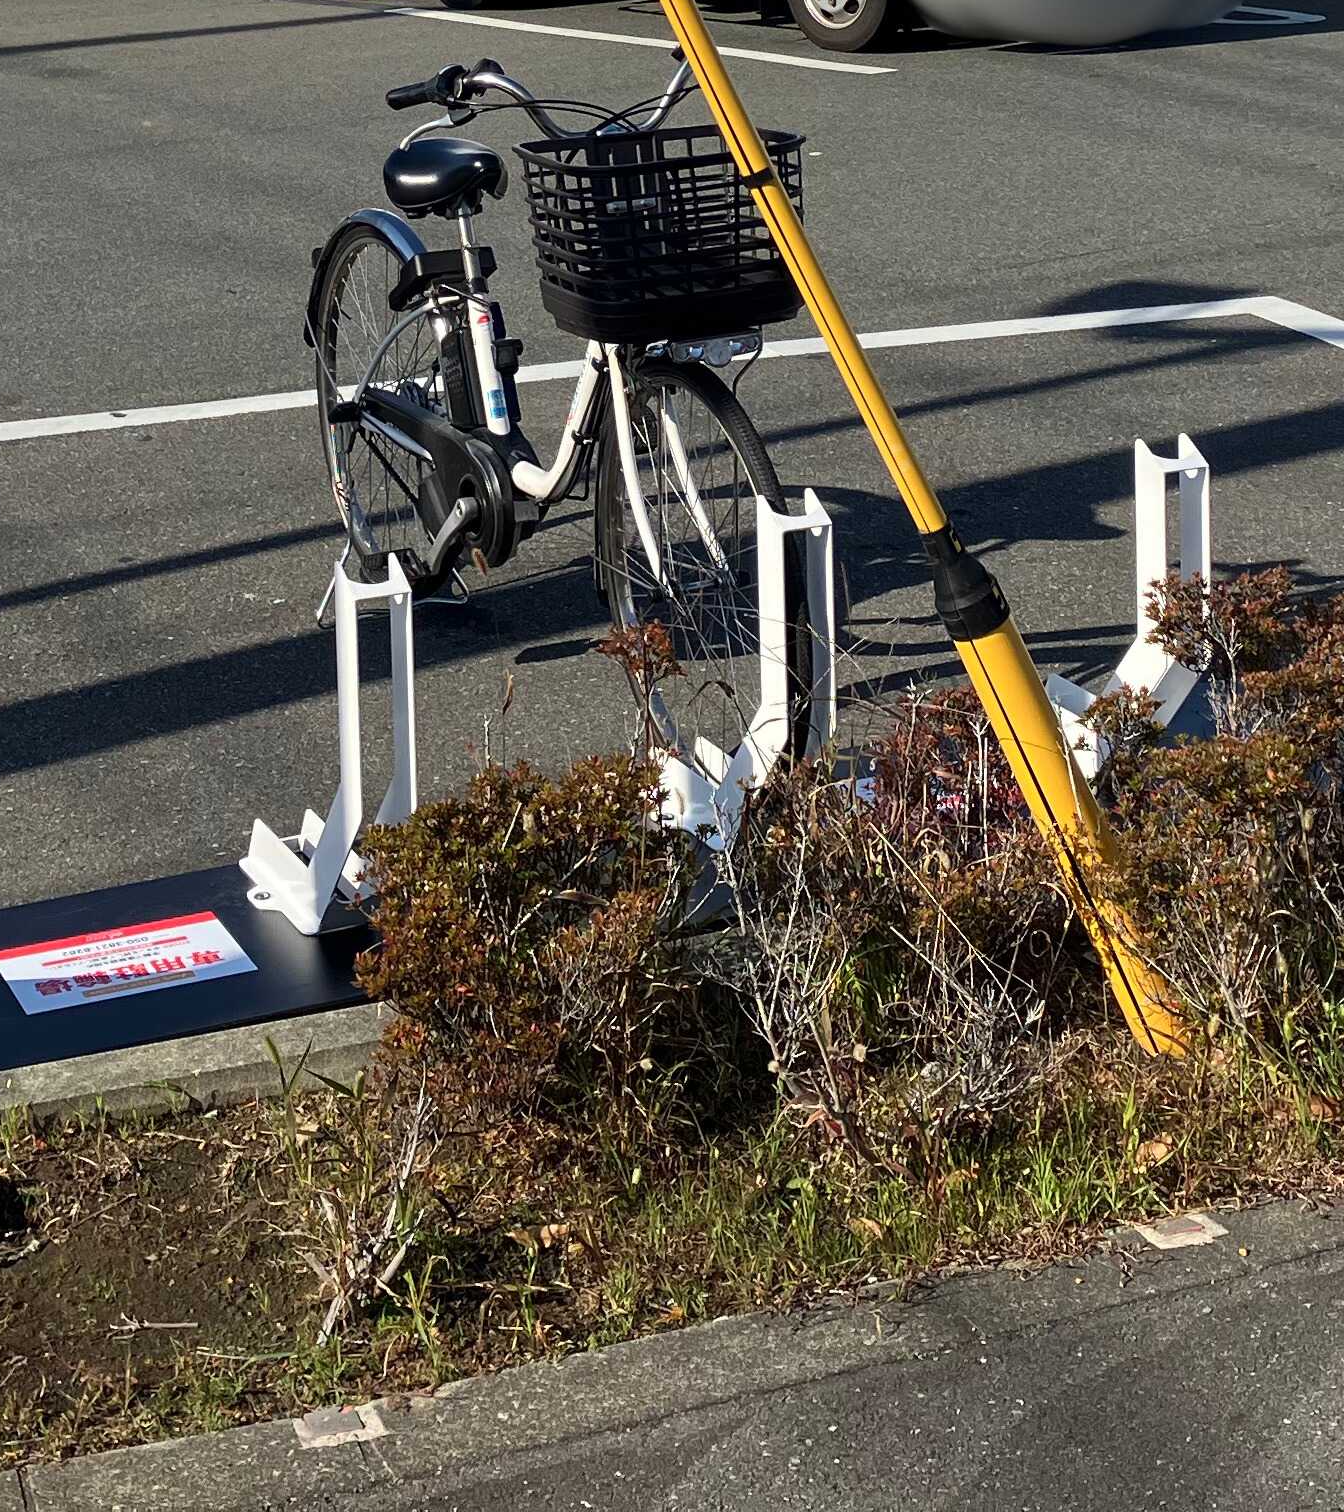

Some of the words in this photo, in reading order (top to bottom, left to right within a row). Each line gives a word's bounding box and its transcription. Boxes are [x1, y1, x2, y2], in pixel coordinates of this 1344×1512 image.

[34, 950, 226, 997] 専用駐輪場
